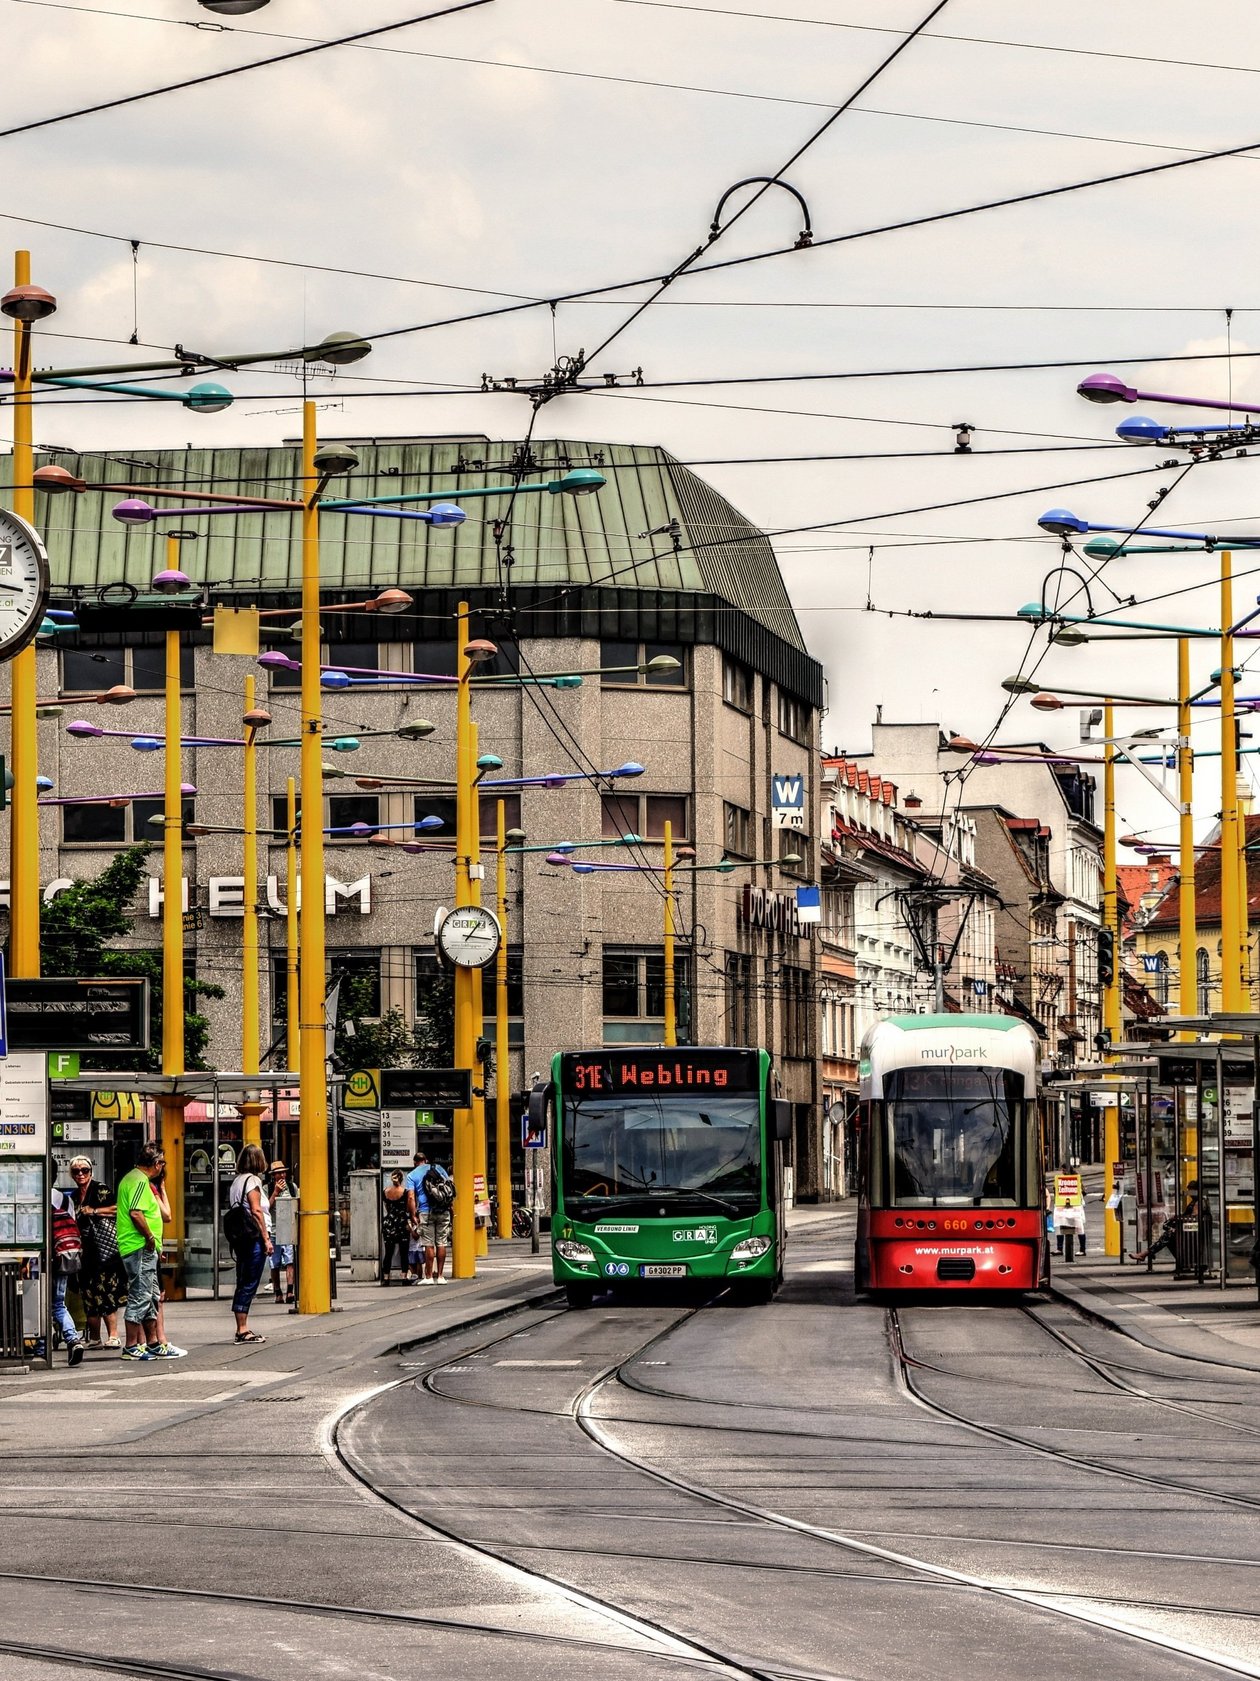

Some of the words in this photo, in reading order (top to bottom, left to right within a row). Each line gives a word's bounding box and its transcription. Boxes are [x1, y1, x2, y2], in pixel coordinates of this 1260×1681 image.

[775, 781, 800, 803] W
[779, 813, 787, 824] 7
[791, 816, 803, 824] m
[749, 885, 813, 938] DOROTHE
[197, 920, 203, 928] 6
[453, 920, 485, 928] GRAZ
[1146, 959, 1157, 969] W
[975, 983, 984, 992] W
[58, 1055, 70, 1072] F
[575, 1065, 603, 1089] 31E
[621, 1064, 728, 1086] Webling
[1204, 1089, 1214, 1099] G
[422, 1112, 429, 1122] F
[5, 1126, 18, 1134] N3
[21, 1126, 34, 1134] N6
[55, 1124, 62, 1134] C
[944, 1220, 967, 1230] 660
[562, 1228, 572, 1238] 17
[673, 1230, 717, 1241] GRAZ
[915, 1246, 994, 1255] www.murpark.at
